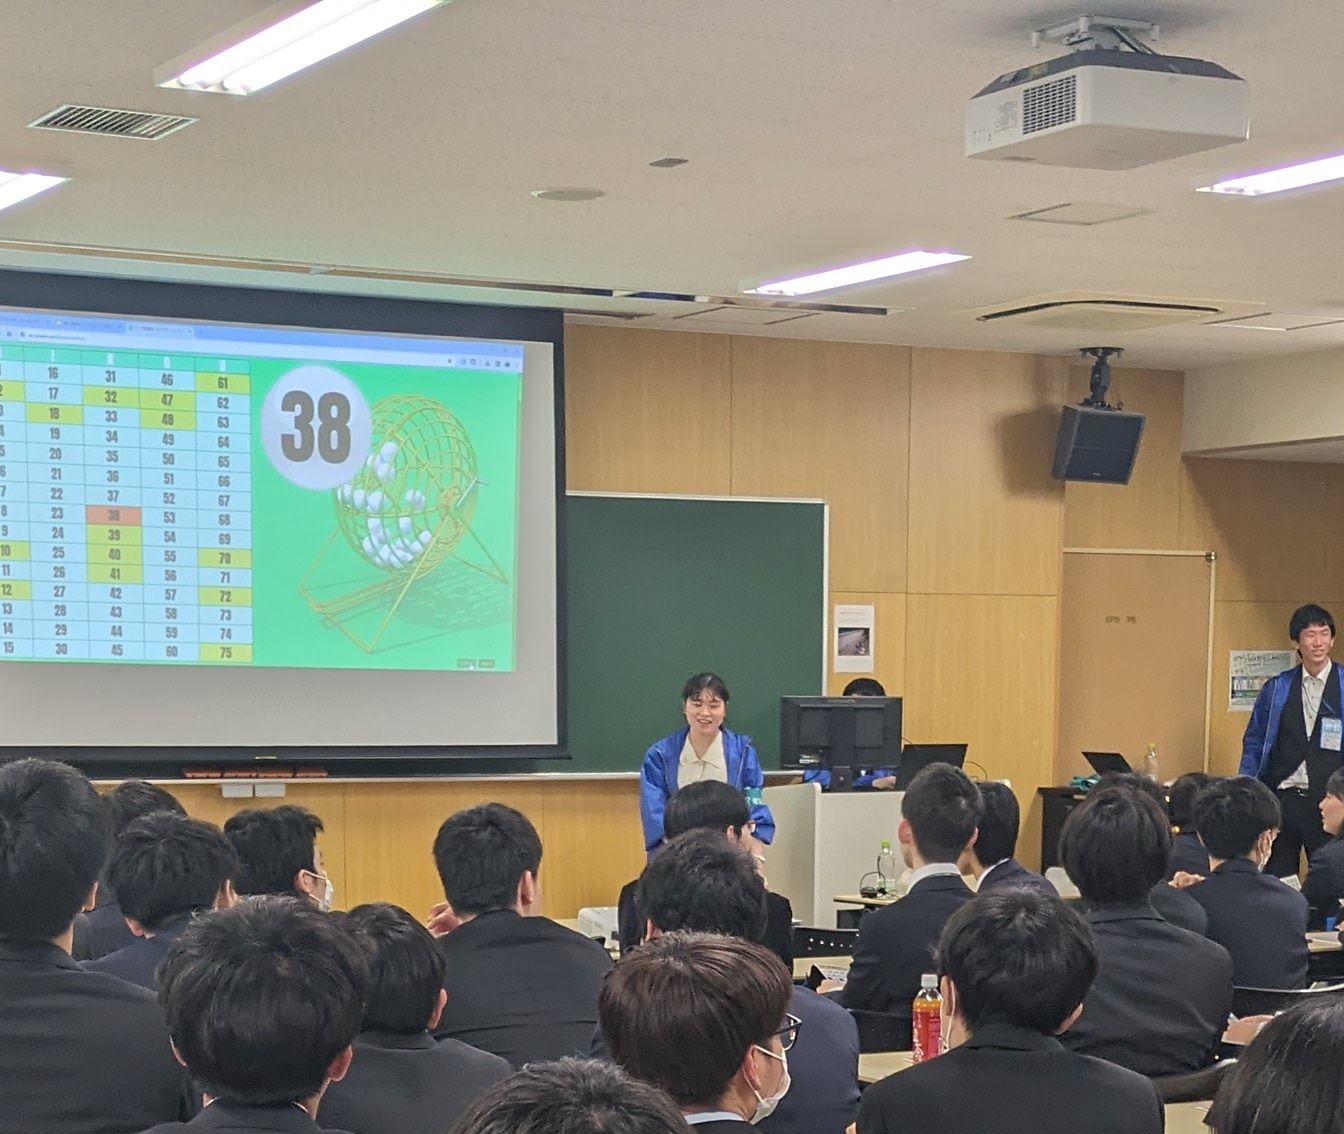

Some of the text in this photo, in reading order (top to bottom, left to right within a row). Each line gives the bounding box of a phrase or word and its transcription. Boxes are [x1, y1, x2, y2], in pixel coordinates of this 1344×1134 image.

[47, 366, 59, 380] 16
[104, 369, 117, 383] 31
[160, 372, 174, 387] 46
[217, 376, 229, 390] 61
[47, 386, 60, 400] 17
[104, 390, 118, 404] 32
[160, 393, 174, 407] 47
[216, 396, 230, 410] 62
[48, 406, 60, 420] 18
[104, 409, 118, 423] 33
[161, 412, 175, 426] 48
[216, 415, 230, 429] 63
[280, 390, 351, 464] 38
[49, 426, 61, 440] 19
[105, 429, 119, 443] 34
[161, 432, 175, 446] 49
[217, 435, 230, 449] 64
[49, 447, 63, 461] 20
[105, 449, 119, 463] 35
[162, 452, 175, 466] 50
[217, 455, 230, 469] 65
[0, 464, 231, 488] 6 21 36 51 66
[0, 484, 231, 508] 7 22 37 52 67
[0, 504, 231, 526] 8 23 38 53 68
[1, 524, 232, 546] 9 24 39 54 69
[0, 543, 232, 565] 10 25 40 55 70
[1, 563, 231, 584] 11 26 41 56 71
[1, 583, 232, 603] 12 27 42 57 72
[1, 602, 232, 622] 13 28 43 58 73
[2, 621, 232, 641] 14 29 44 59 74
[3, 641, 233, 659] 15 30 45 60 75
